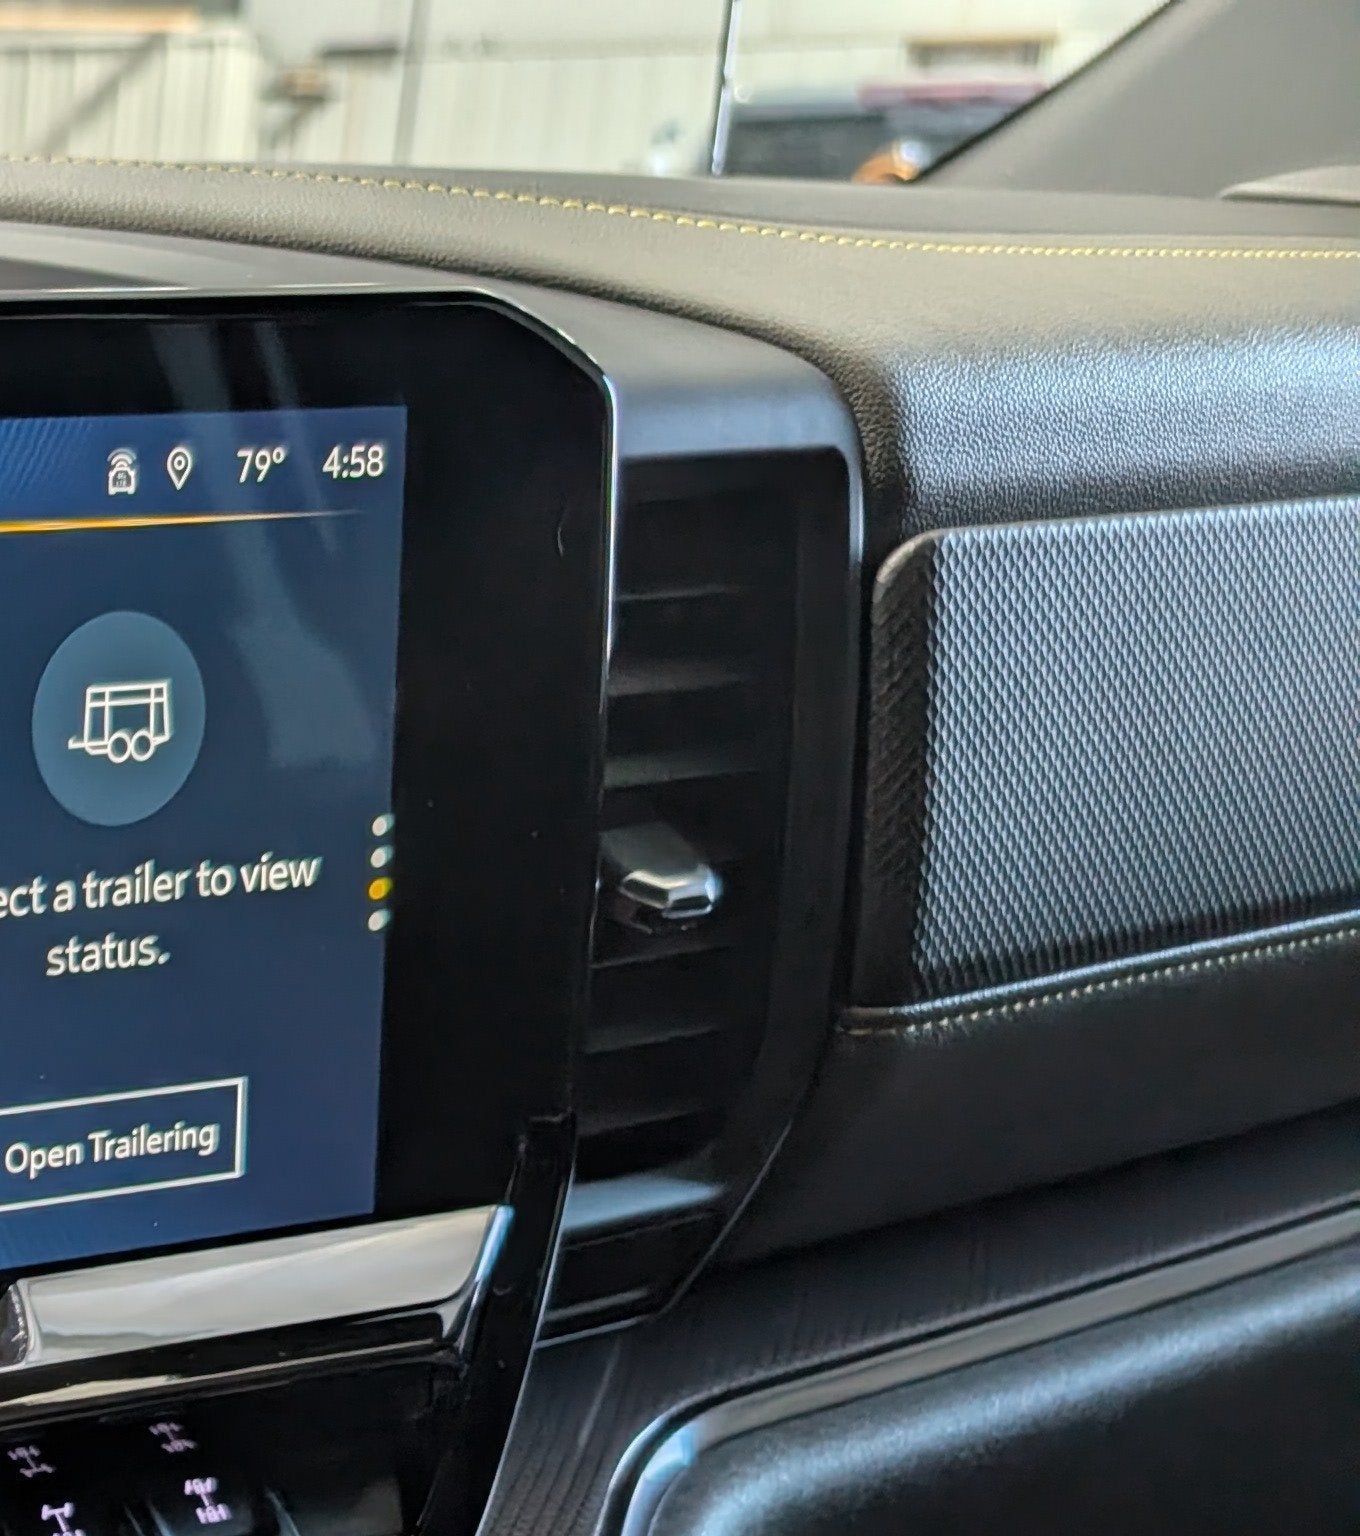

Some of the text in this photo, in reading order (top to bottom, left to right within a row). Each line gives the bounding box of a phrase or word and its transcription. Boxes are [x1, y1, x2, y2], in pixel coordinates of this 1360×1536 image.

[322, 445, 384, 480] 4:58
[54, 885, 73, 911] a
[82, 860, 188, 908] trailer
[197, 864, 235, 894] to
[241, 851, 321, 892] view
[46, 932, 169, 975] status.
[6, 1121, 218, 1177] Open Trailering
